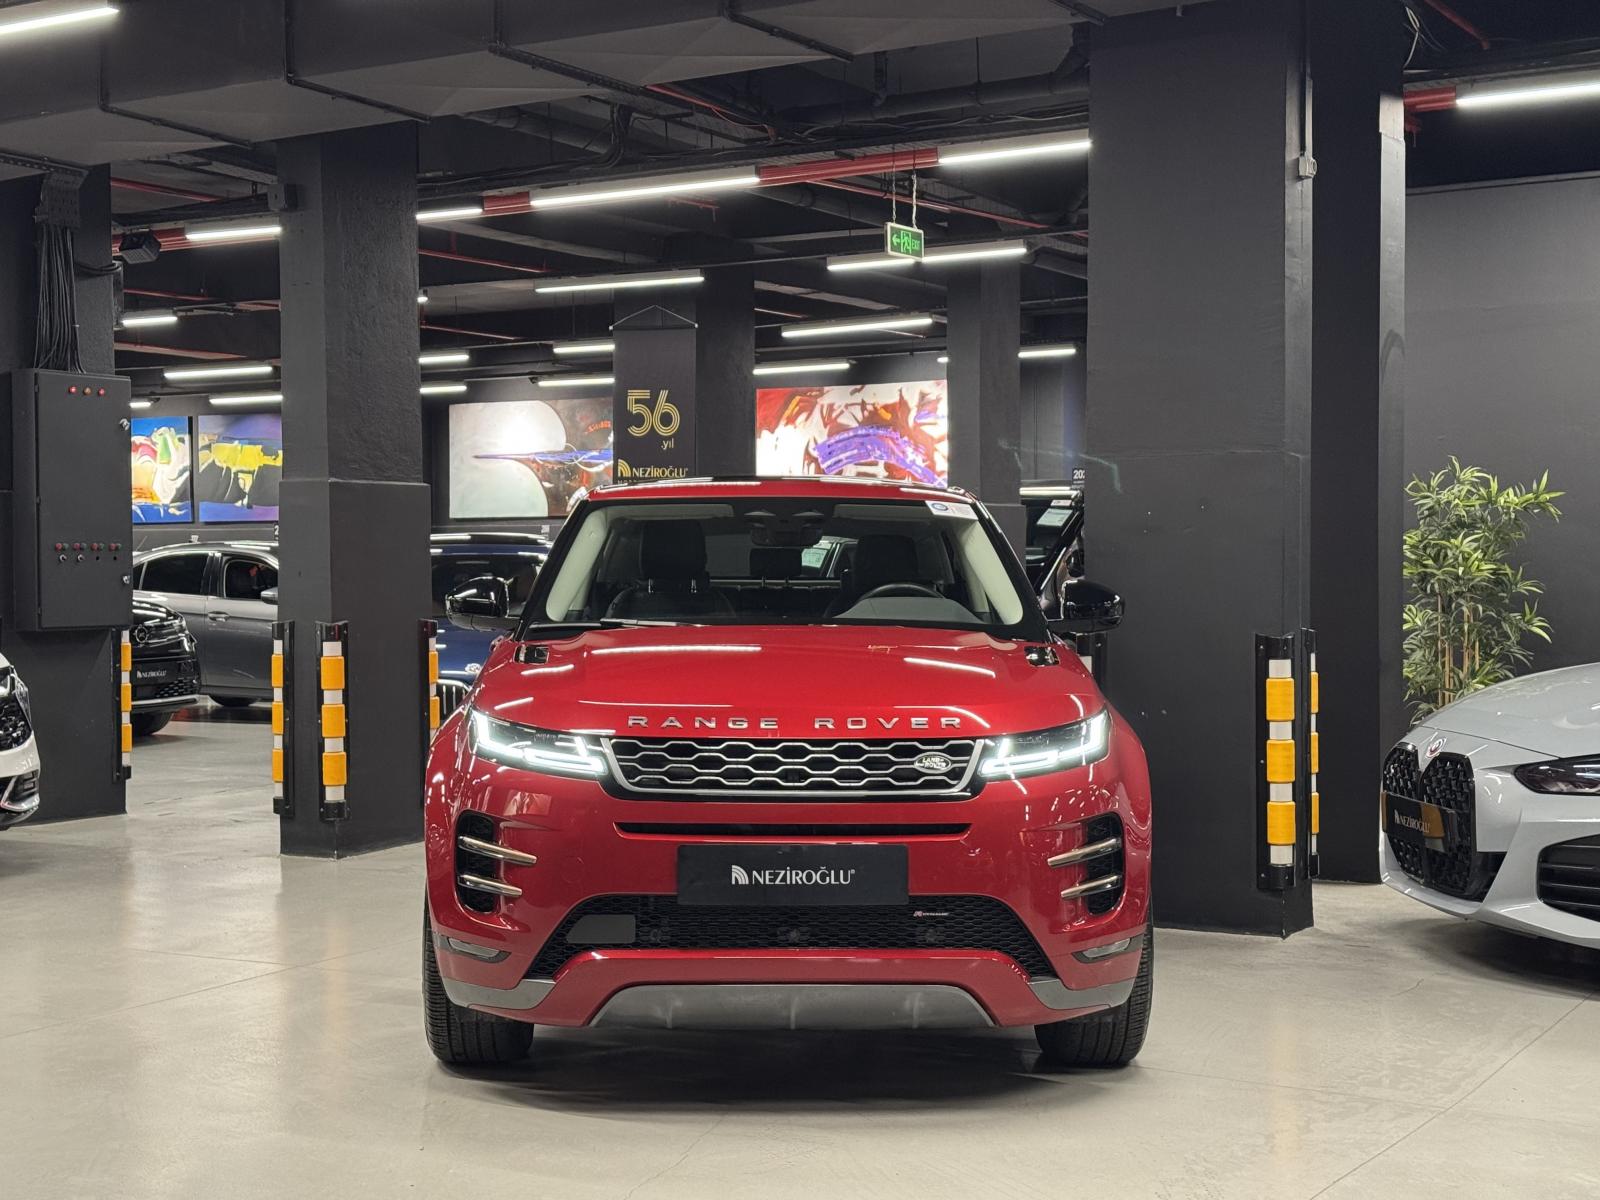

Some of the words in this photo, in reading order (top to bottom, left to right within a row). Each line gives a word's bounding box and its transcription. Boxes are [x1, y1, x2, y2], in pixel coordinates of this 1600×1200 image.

[627, 389, 680, 437] 56
[627, 715, 779, 730] RANGE
[814, 717, 961, 730] ROVER
[752, 866, 851, 885] NEZİROĞLU
